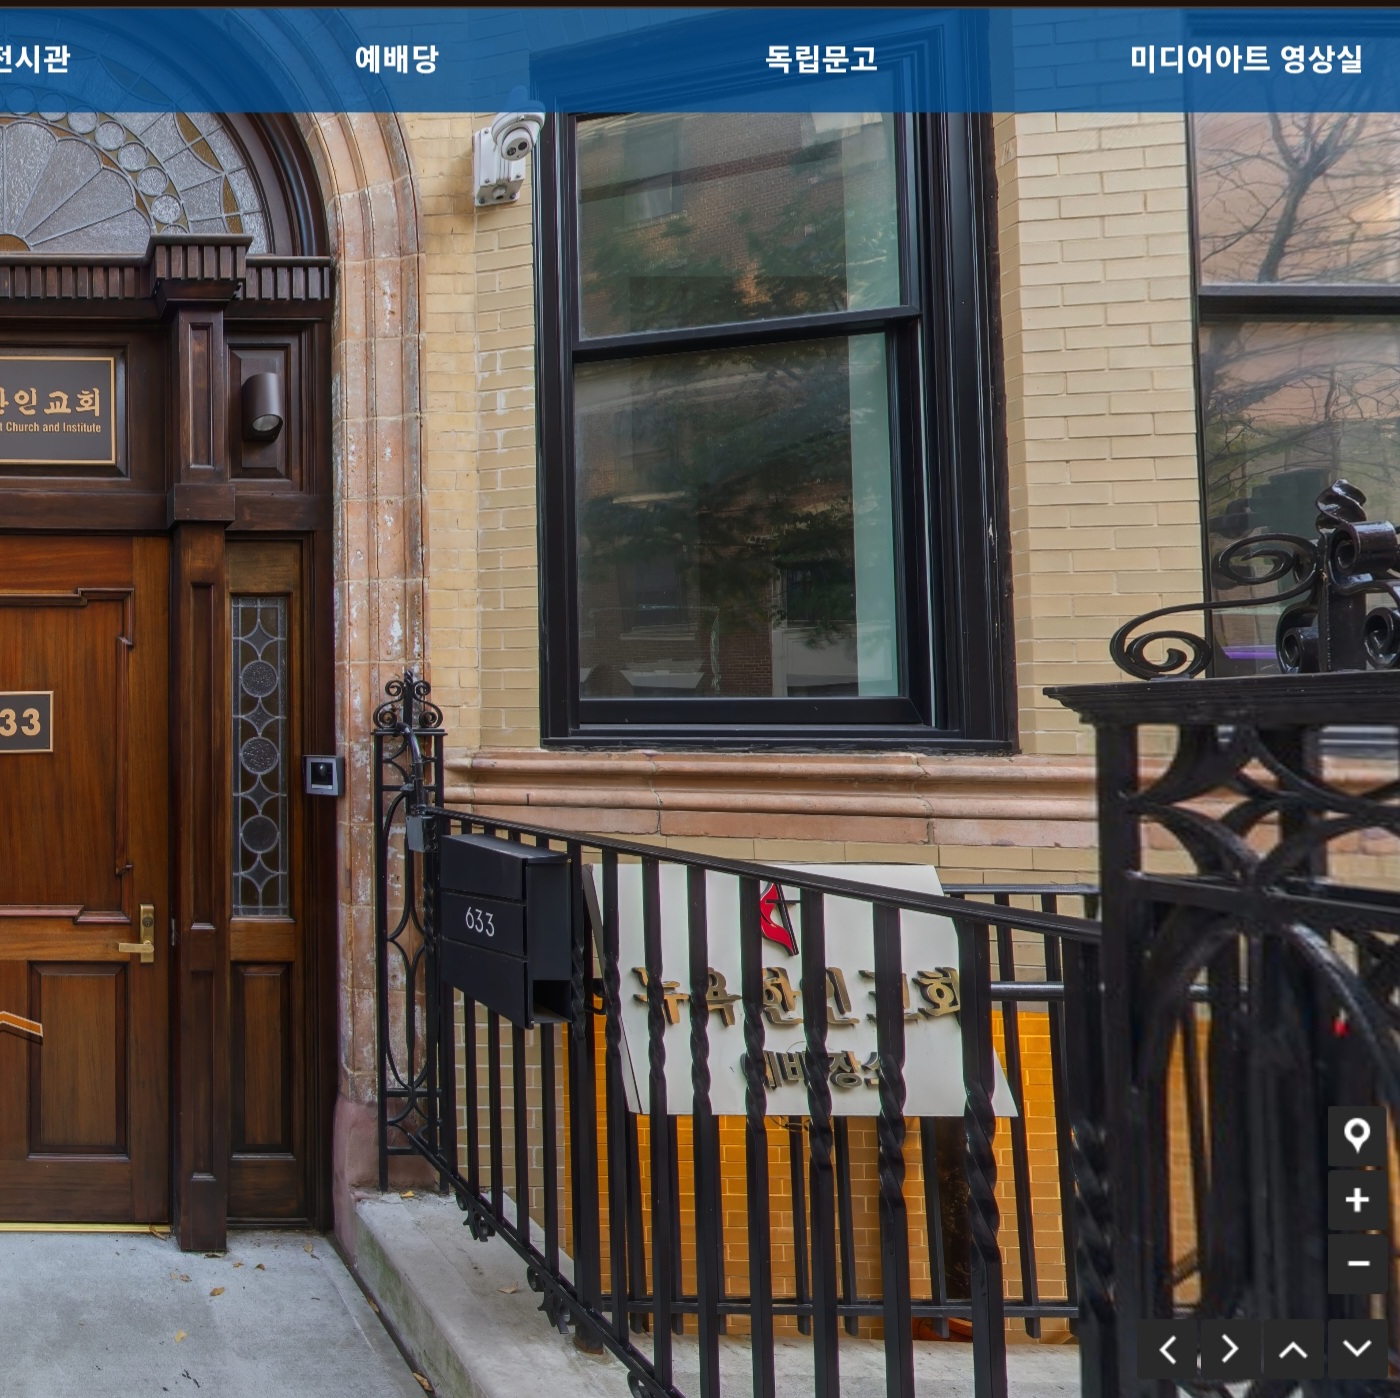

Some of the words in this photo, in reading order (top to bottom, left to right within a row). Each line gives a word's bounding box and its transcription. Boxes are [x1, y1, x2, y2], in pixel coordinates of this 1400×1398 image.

[5, 421, 40, 433] Church
[42, 421, 60, 433] and
[63, 421, 102, 433] Institute
[464, 905, 496, 938] 633
